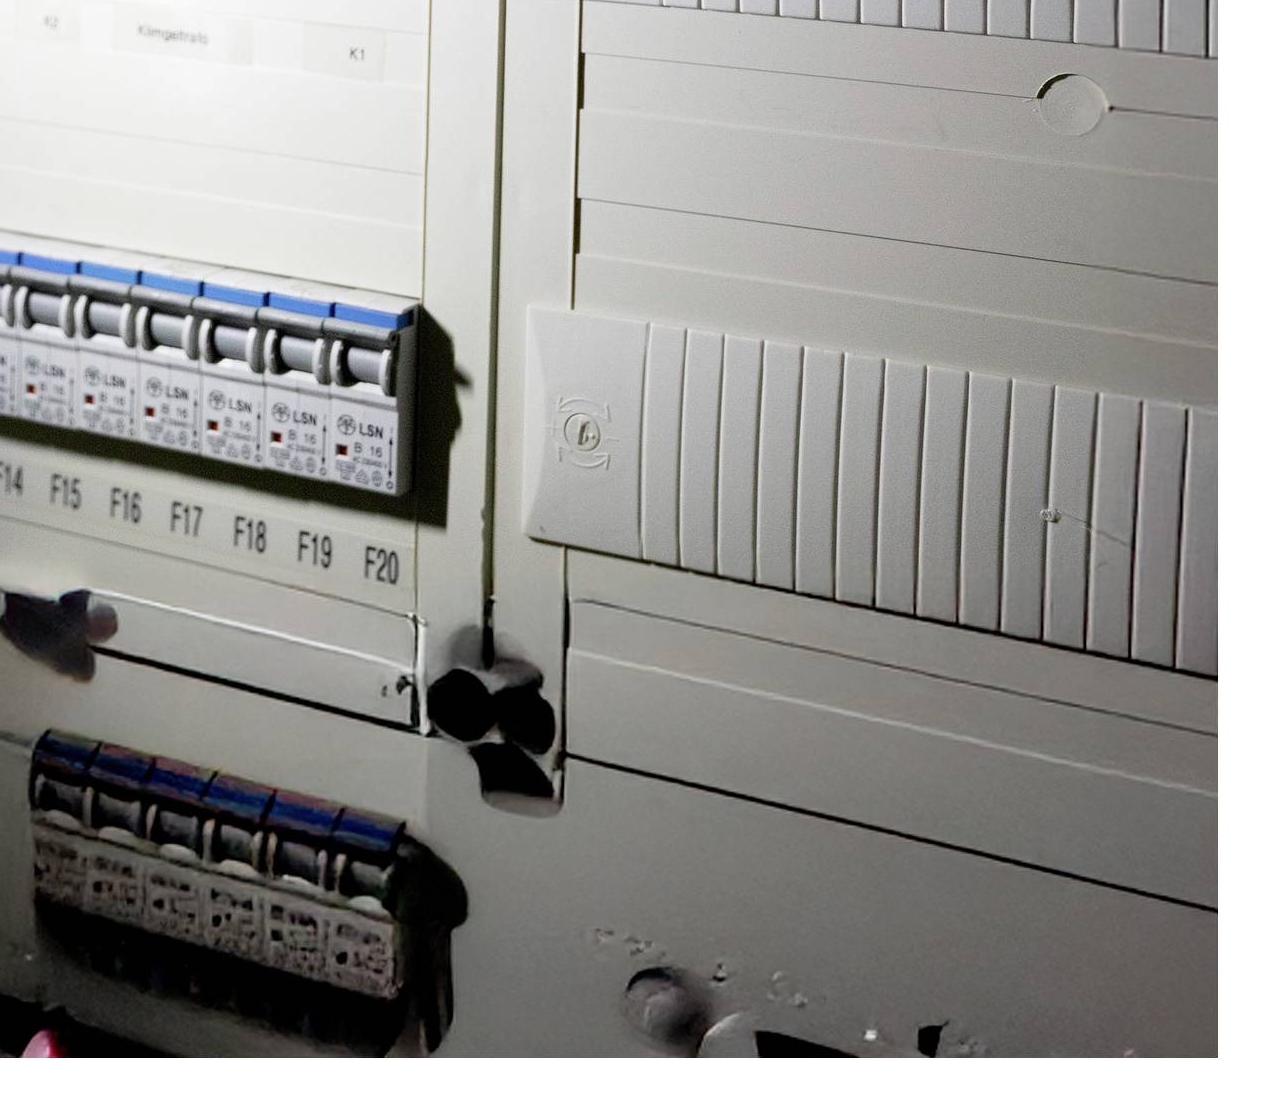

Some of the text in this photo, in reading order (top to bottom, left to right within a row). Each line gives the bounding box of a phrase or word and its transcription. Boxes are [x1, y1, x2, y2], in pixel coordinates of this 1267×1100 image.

[349, 46, 365, 62] K1
[228, 397, 252, 413] LSN
[293, 410, 317, 426] LSN
[359, 422, 384, 439] LSN
[49, 473, 82, 510] F15
[109, 486, 143, 524] F16
[169, 500, 203, 537] F17
[233, 515, 267, 554] F18
[297, 530, 333, 569] F19
[365, 545, 399, 585] F20
